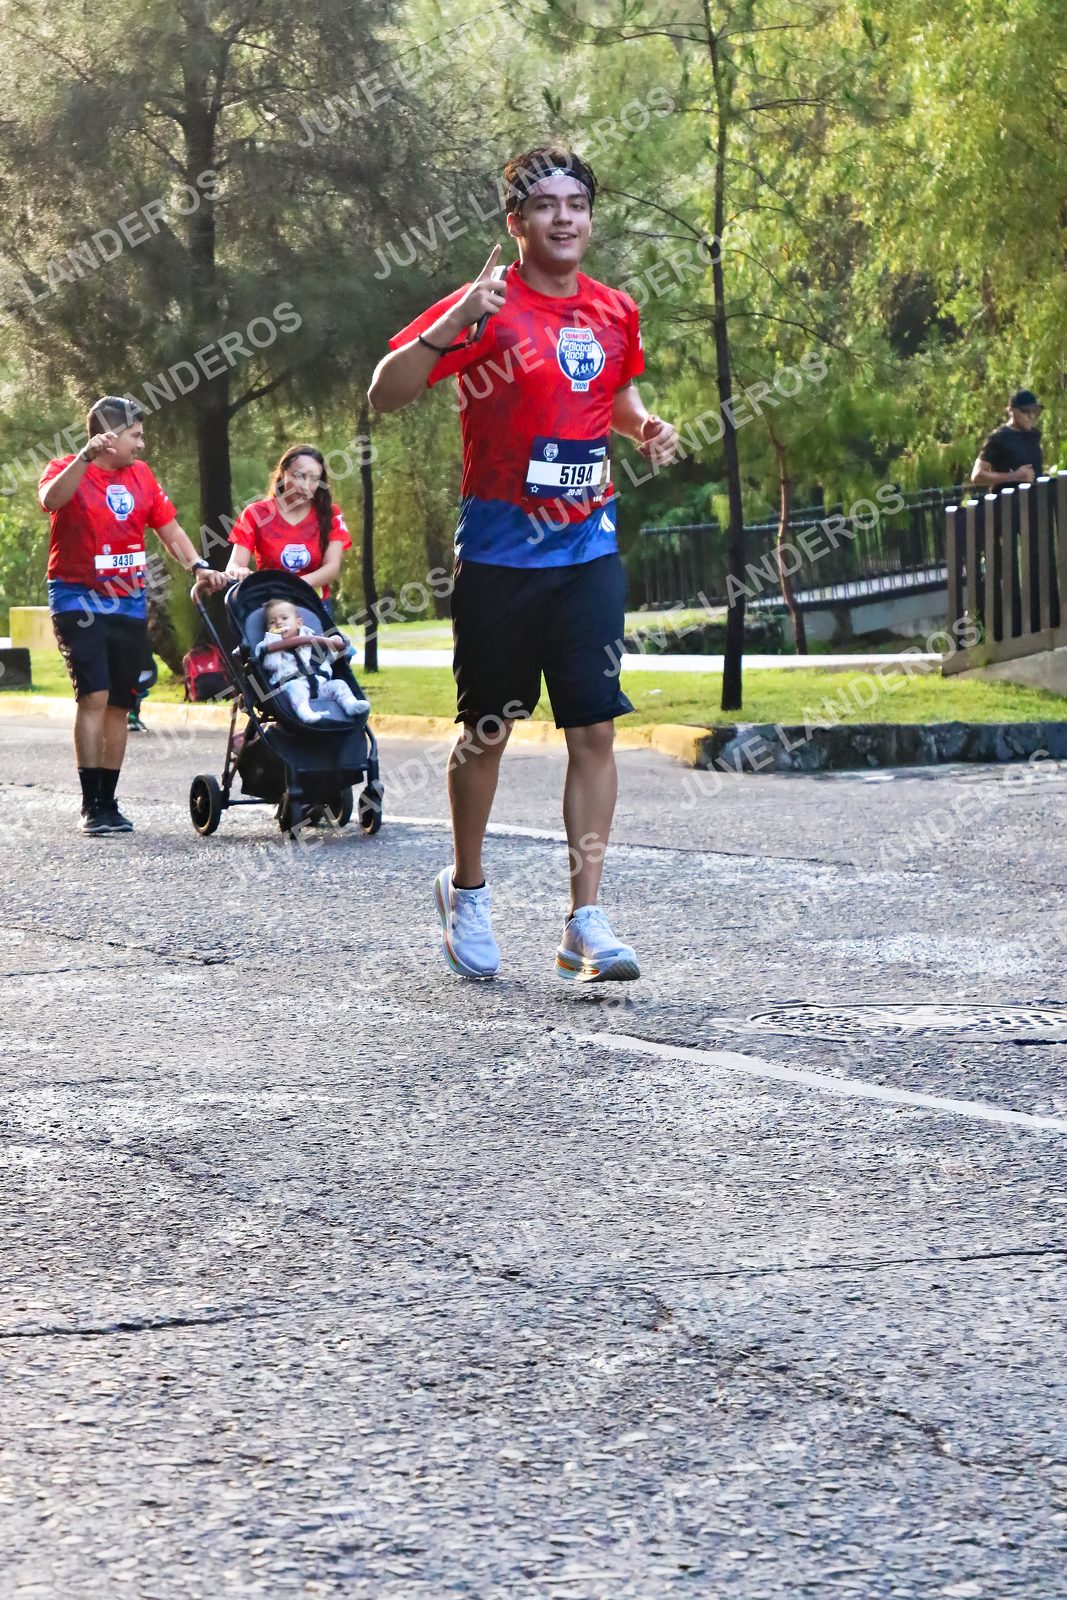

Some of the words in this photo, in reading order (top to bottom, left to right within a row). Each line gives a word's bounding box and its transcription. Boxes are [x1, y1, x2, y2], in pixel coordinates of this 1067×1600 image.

[568, 341, 591, 352] Global
[564, 350, 584, 360] Race
[559, 465, 593, 485] 5194
[112, 554, 134, 567] 3430
